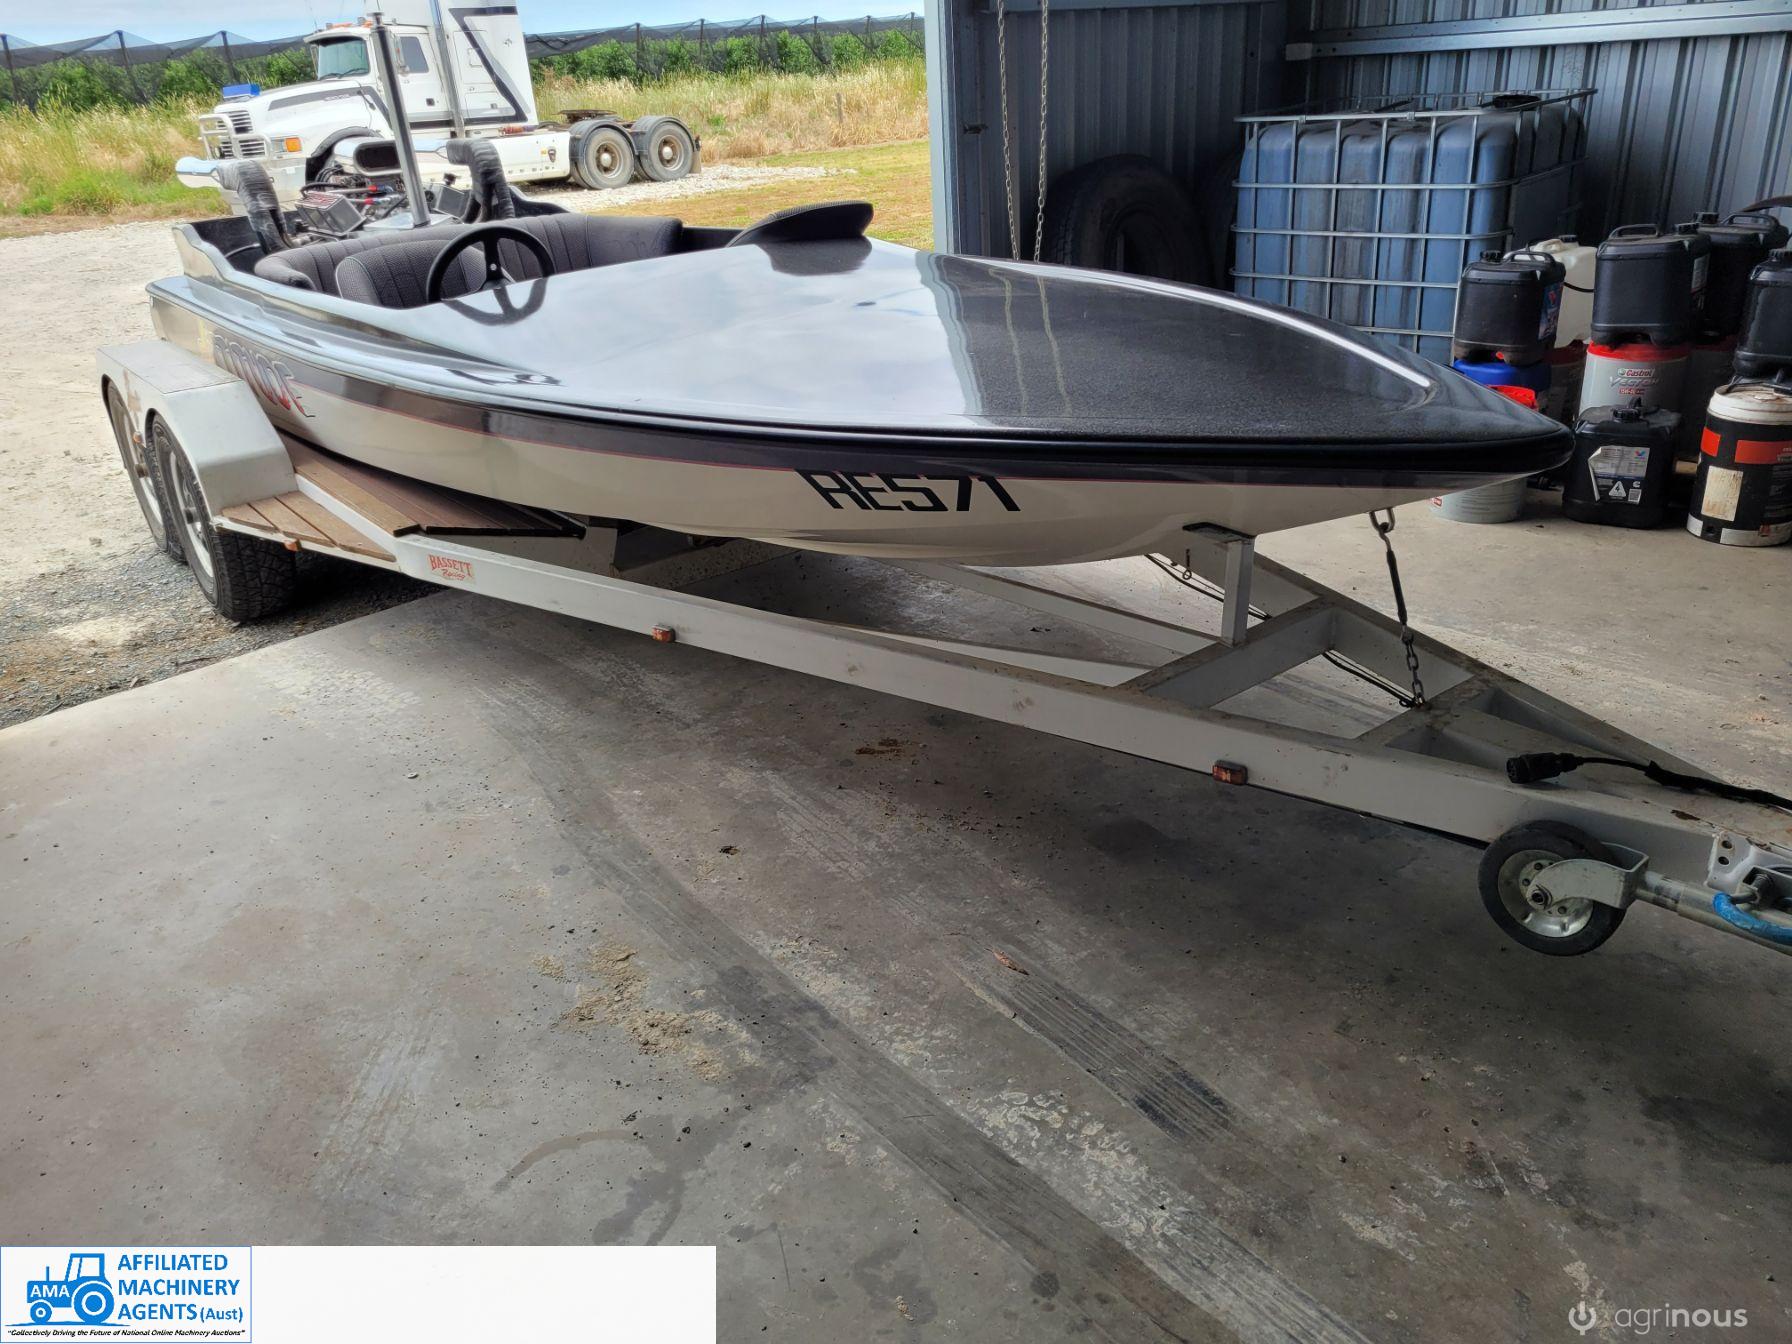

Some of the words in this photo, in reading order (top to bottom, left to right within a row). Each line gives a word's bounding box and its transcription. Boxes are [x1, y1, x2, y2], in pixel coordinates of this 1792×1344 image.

[1626, 369, 1653, 377] Castrol
[795, 468, 1021, 512] RE571
[428, 553, 472, 577] BASSETT
